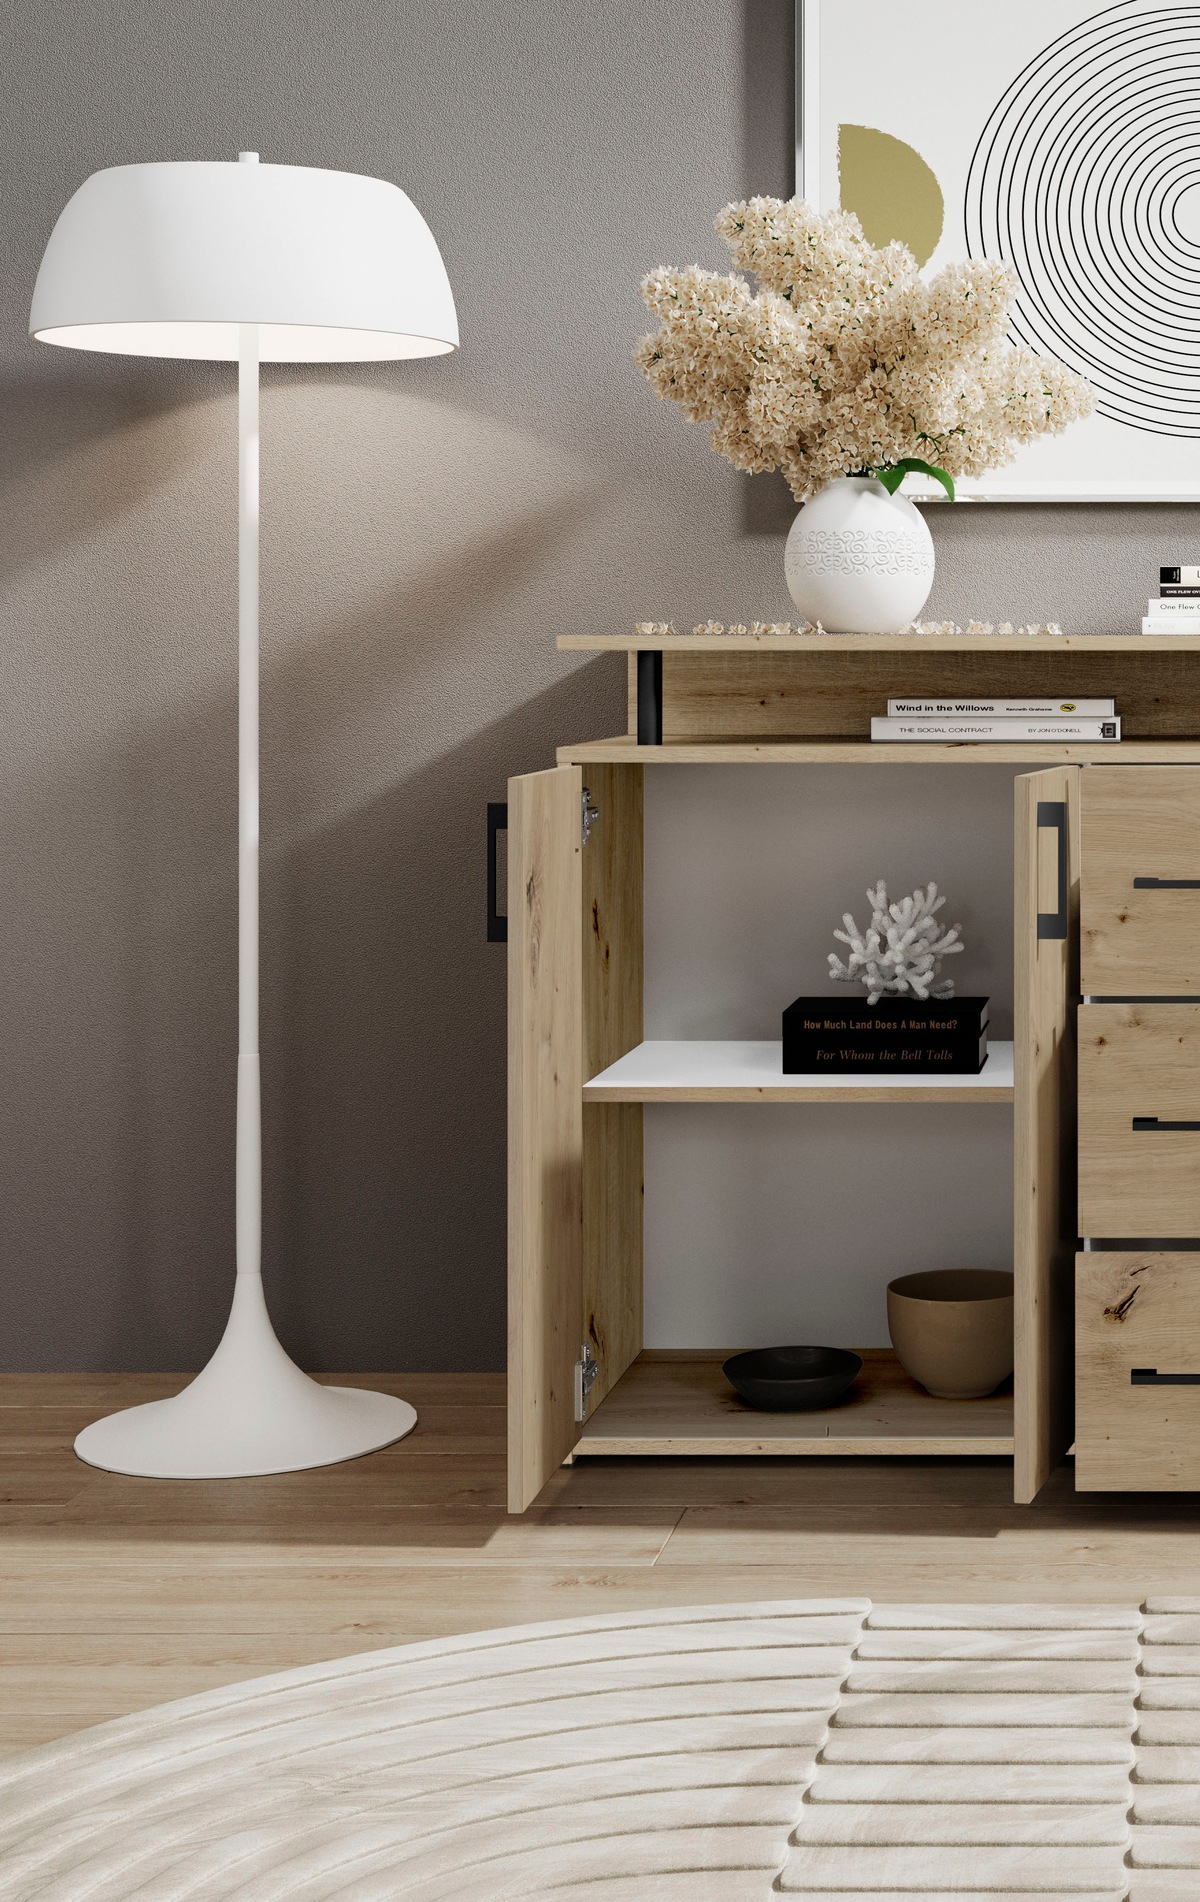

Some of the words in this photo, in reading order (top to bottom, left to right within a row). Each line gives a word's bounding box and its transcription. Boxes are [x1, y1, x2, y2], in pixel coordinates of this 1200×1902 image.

[895, 704, 922, 712] Wind
[924, 704, 934, 712] in
[936, 704, 953, 712] the
[955, 704, 995, 712] Willows
[803, 1020, 822, 1030] How
[823, 1020, 847, 1030] Much
[849, 1020, 873, 1030] Land
[875, 1020, 898, 1030] Does
[900, 1020, 907, 1030] A
[909, 1020, 927, 1030] Man
[929, 1020, 958, 1030] Need?
[816, 1050, 836, 1060] For
[839, 1050, 875, 1060] Whom
[879, 1050, 897, 1060] the
[901, 1050, 922, 1060] Bell
[926, 1050, 953, 1060] Tolls
